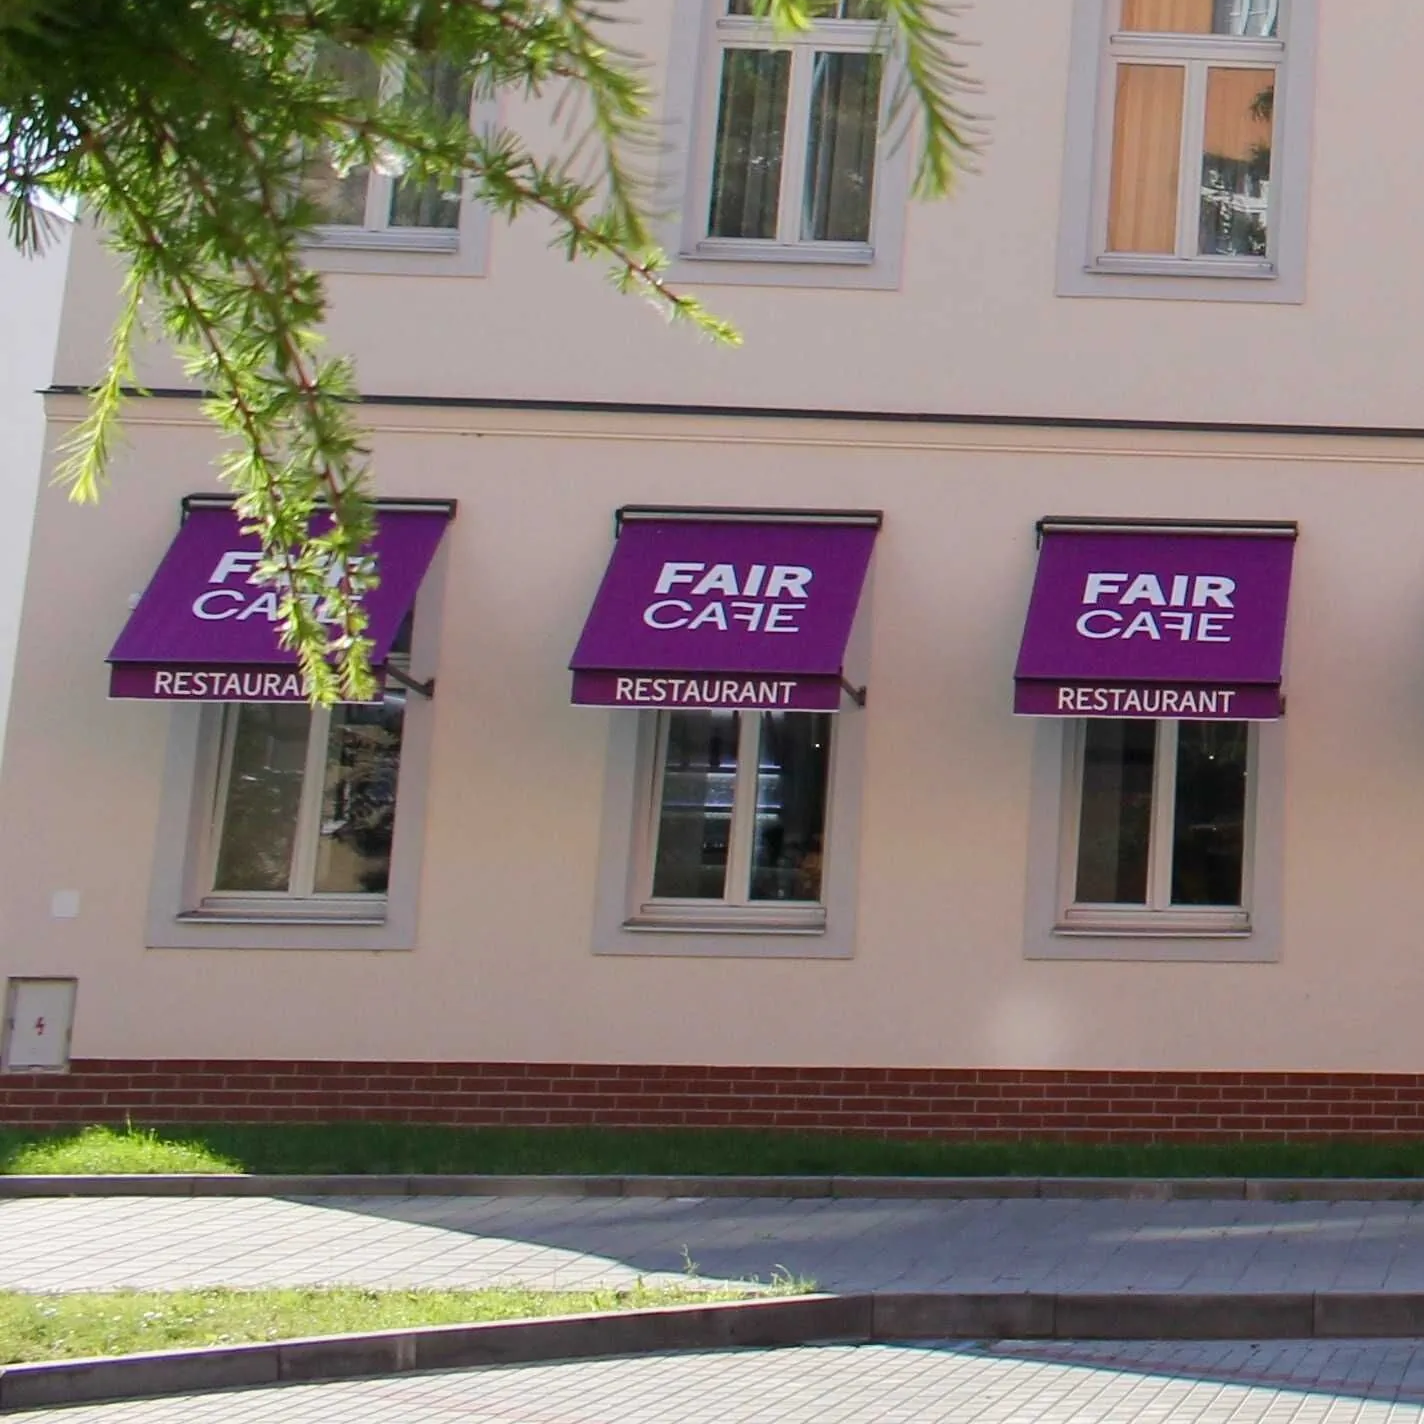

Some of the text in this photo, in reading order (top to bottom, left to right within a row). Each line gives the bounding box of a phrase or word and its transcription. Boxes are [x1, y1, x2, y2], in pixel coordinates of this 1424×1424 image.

[653, 562, 813, 598] FAIR
[1082, 572, 1236, 608] FAIR
[643, 599, 807, 633] CAFE
[1076, 609, 1235, 642] CAFE
[154, 671, 340, 698] RESTAURA
[615, 677, 797, 704] RESTAURANT
[1057, 687, 1237, 713] RESTAURANT
